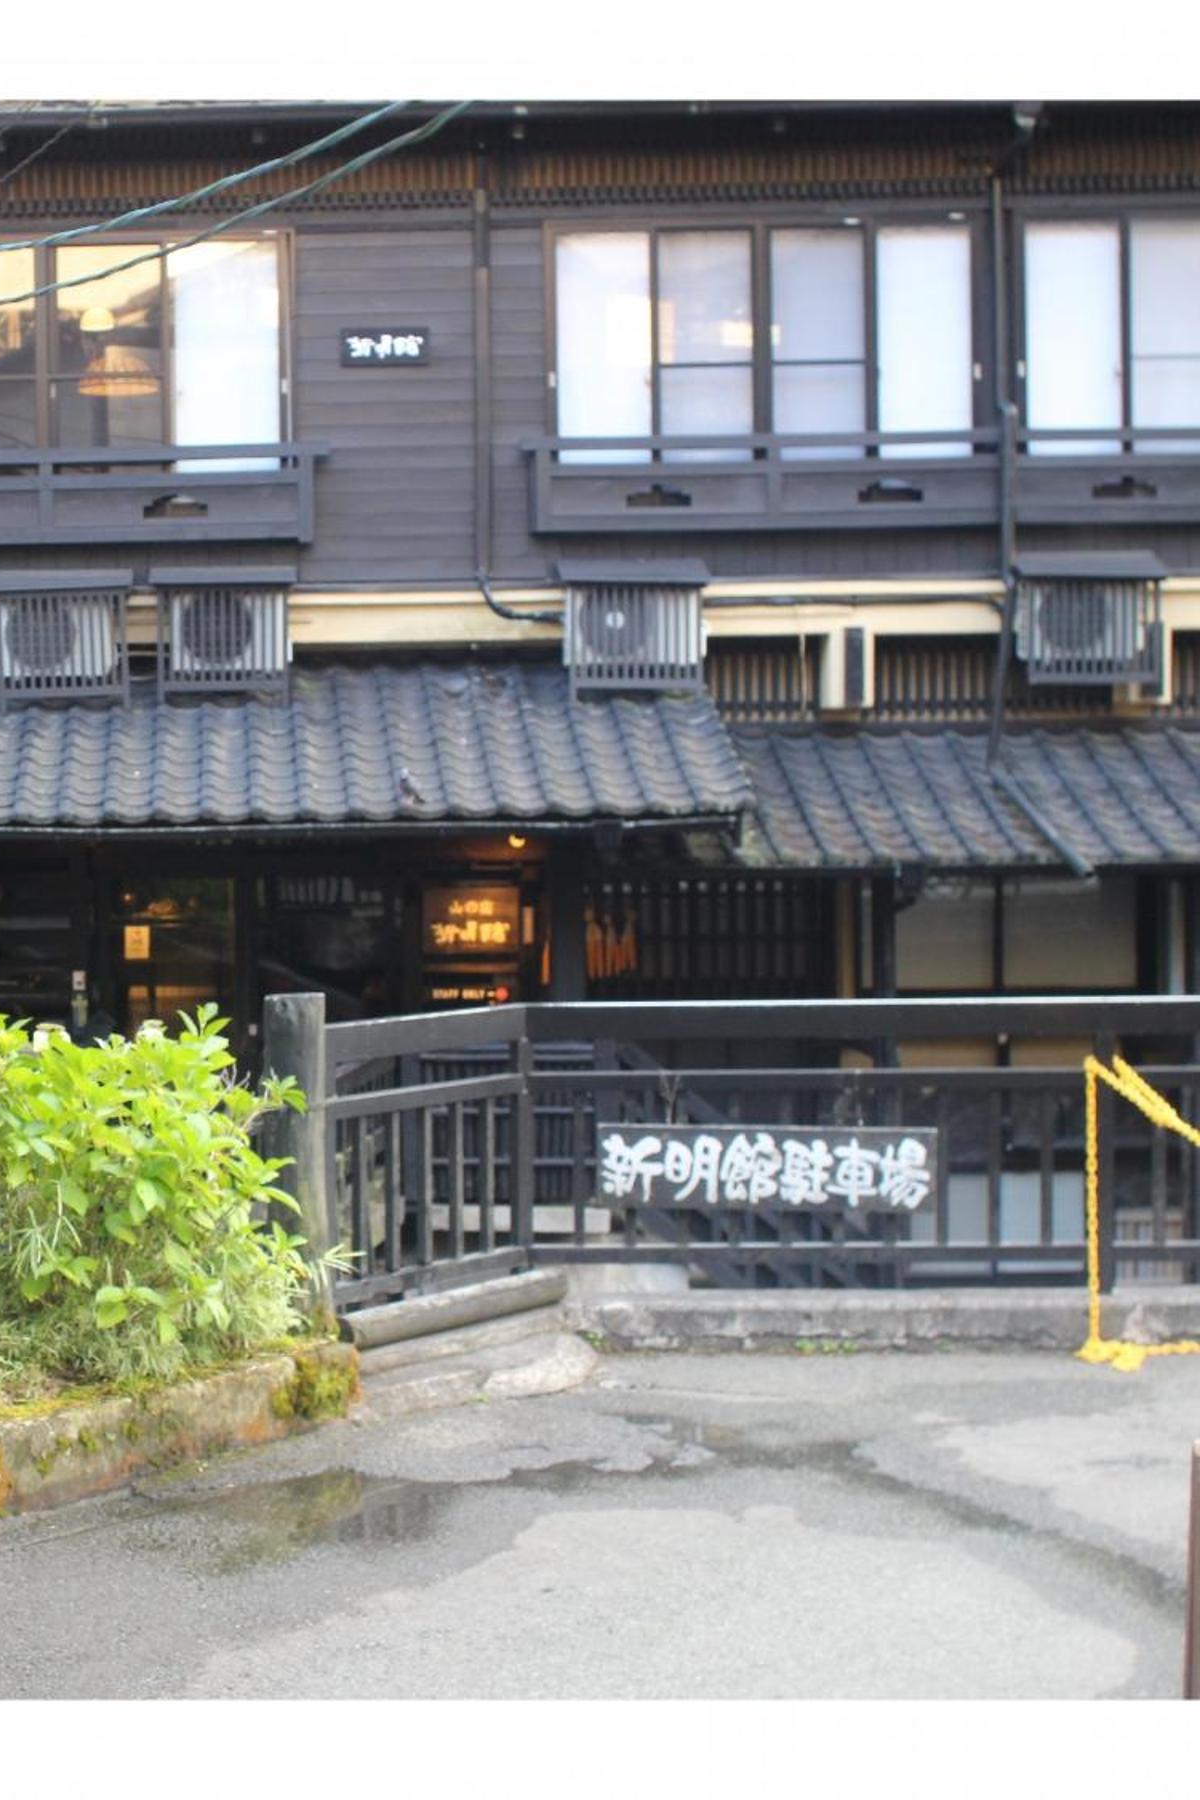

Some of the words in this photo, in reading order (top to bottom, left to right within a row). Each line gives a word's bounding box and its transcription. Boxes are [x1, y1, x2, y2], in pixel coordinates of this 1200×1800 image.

[602, 1133, 931, 1209] 新明館駐車場
